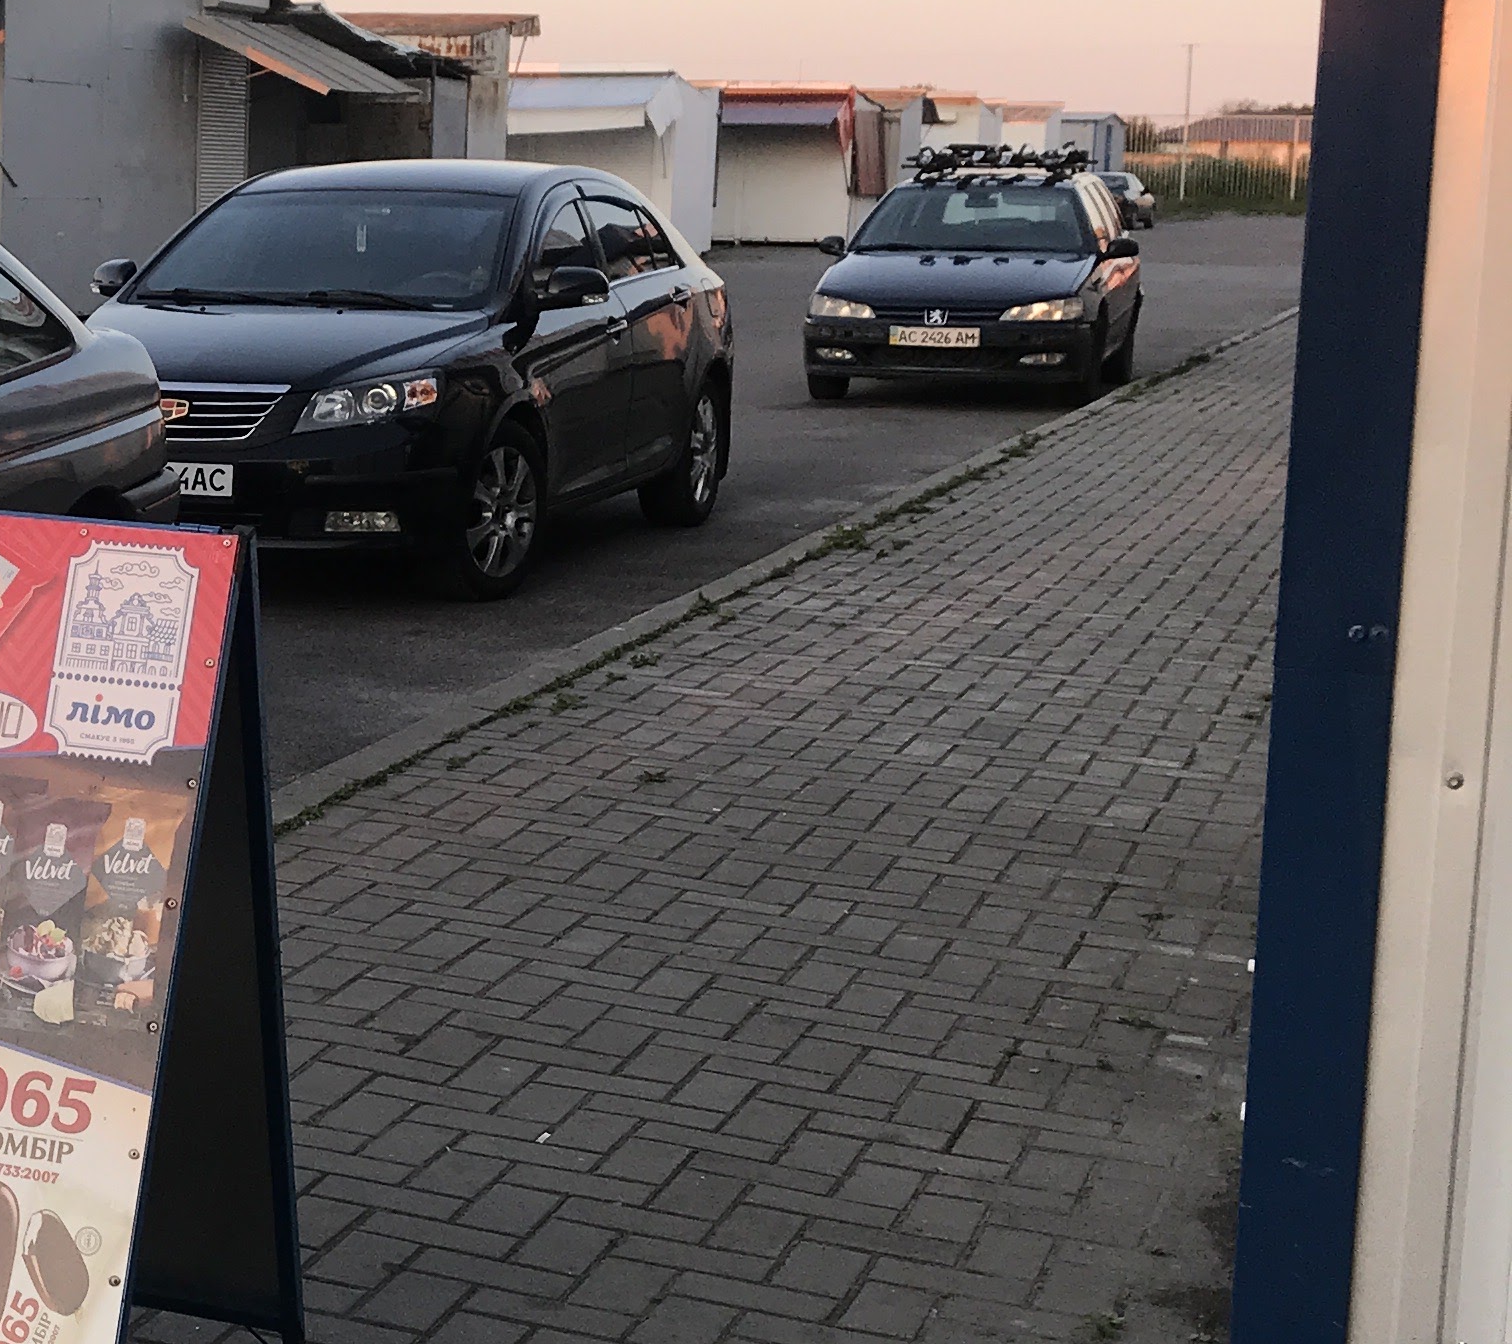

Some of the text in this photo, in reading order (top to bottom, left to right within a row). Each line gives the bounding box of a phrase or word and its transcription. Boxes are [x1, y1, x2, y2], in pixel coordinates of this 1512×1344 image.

[899, 331, 917, 343] AC
[921, 331, 952, 344] 2426
[955, 332, 977, 344] AM
[165, 466, 226, 491] 4AC
[66, 693, 156, 730] лімо
[25, 856, 77, 880] Velvet
[104, 850, 156, 874] Velvet
